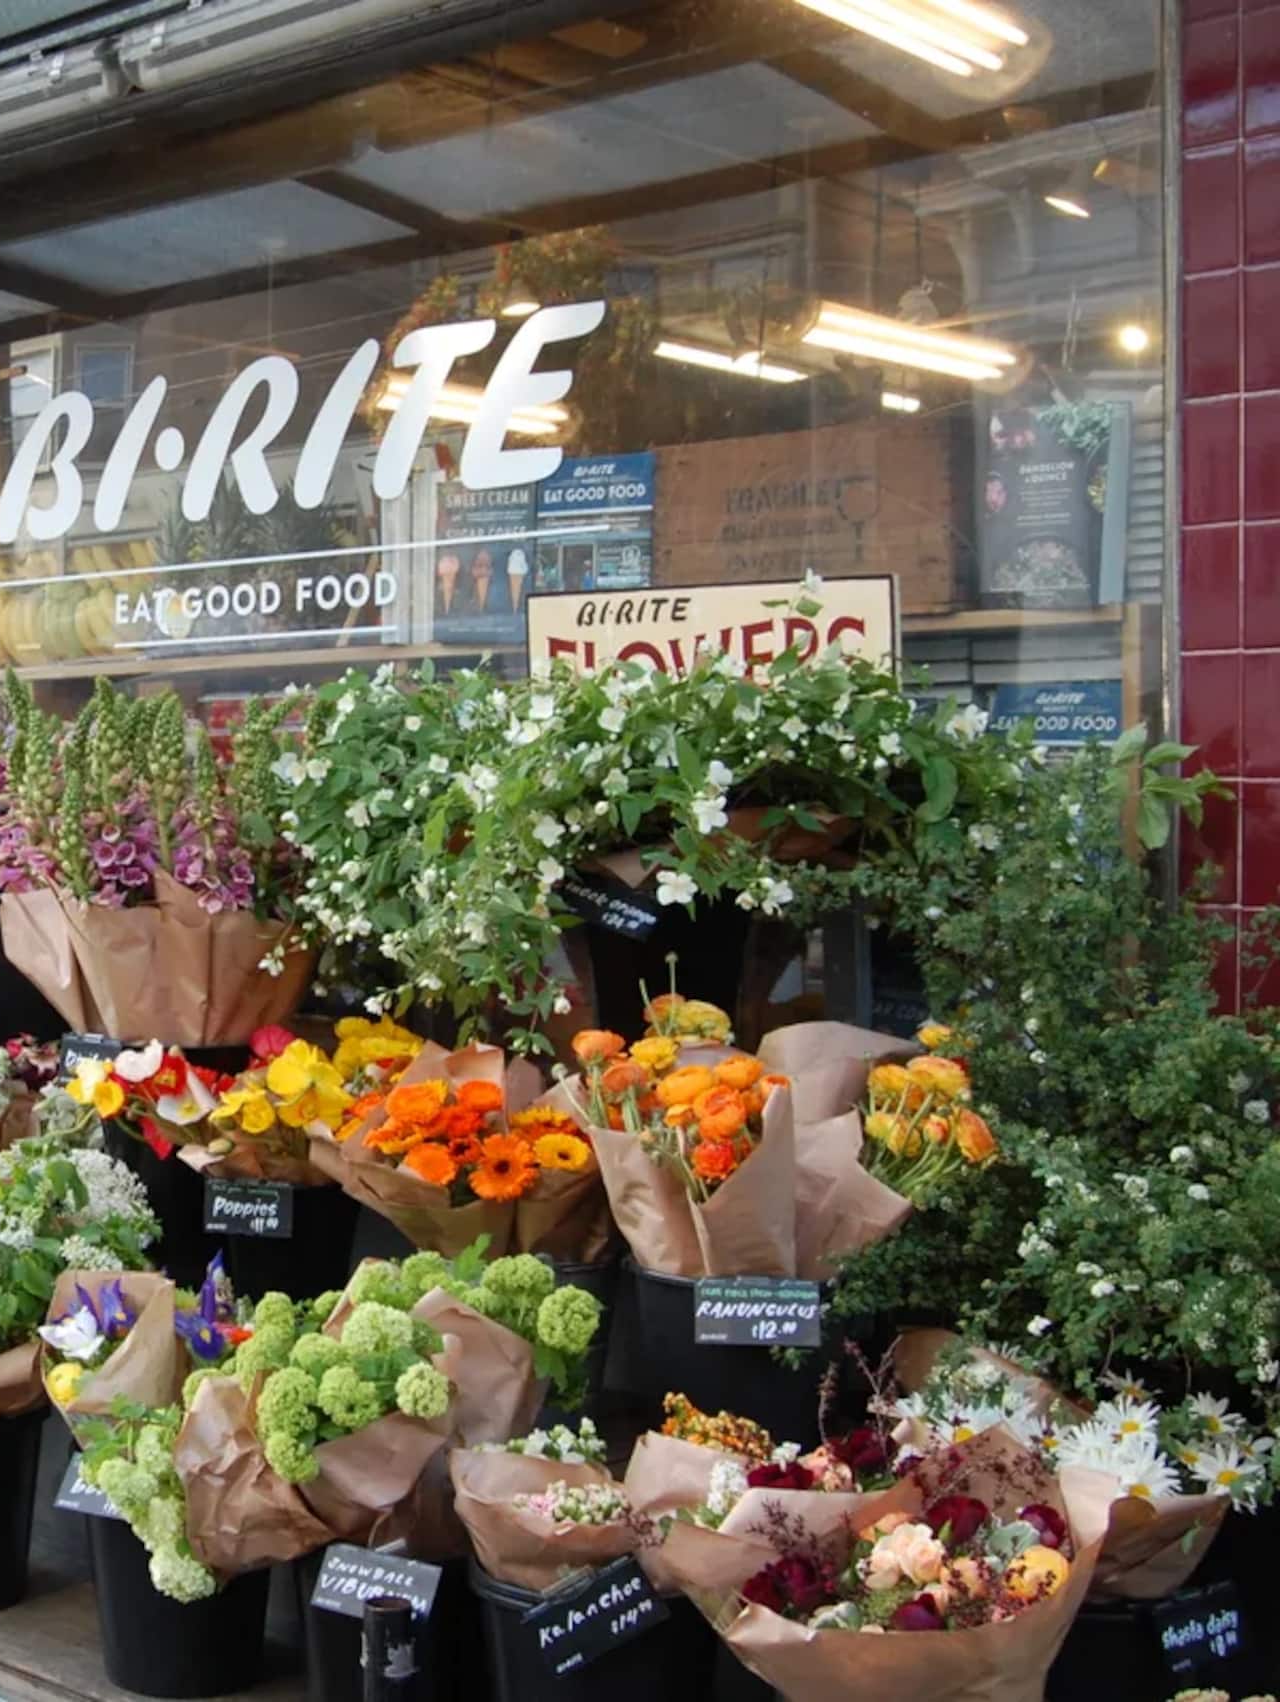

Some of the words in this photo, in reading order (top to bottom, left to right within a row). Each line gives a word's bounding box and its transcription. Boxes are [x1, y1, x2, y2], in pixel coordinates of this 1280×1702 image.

[488, 488, 530, 505] CREAM
[543, 488, 564, 504] EAT
[565, 485, 605, 501] GOOD
[608, 483, 647, 499] FOOD
[114, 589, 172, 625] EAT
[180, 581, 281, 619] GOOD
[296, 571, 398, 613] FOOD
[1072, 714, 1117, 730] FOOD
[212, 1195, 278, 1219] Poppies
[320, 1573, 428, 1612] VIBURM
